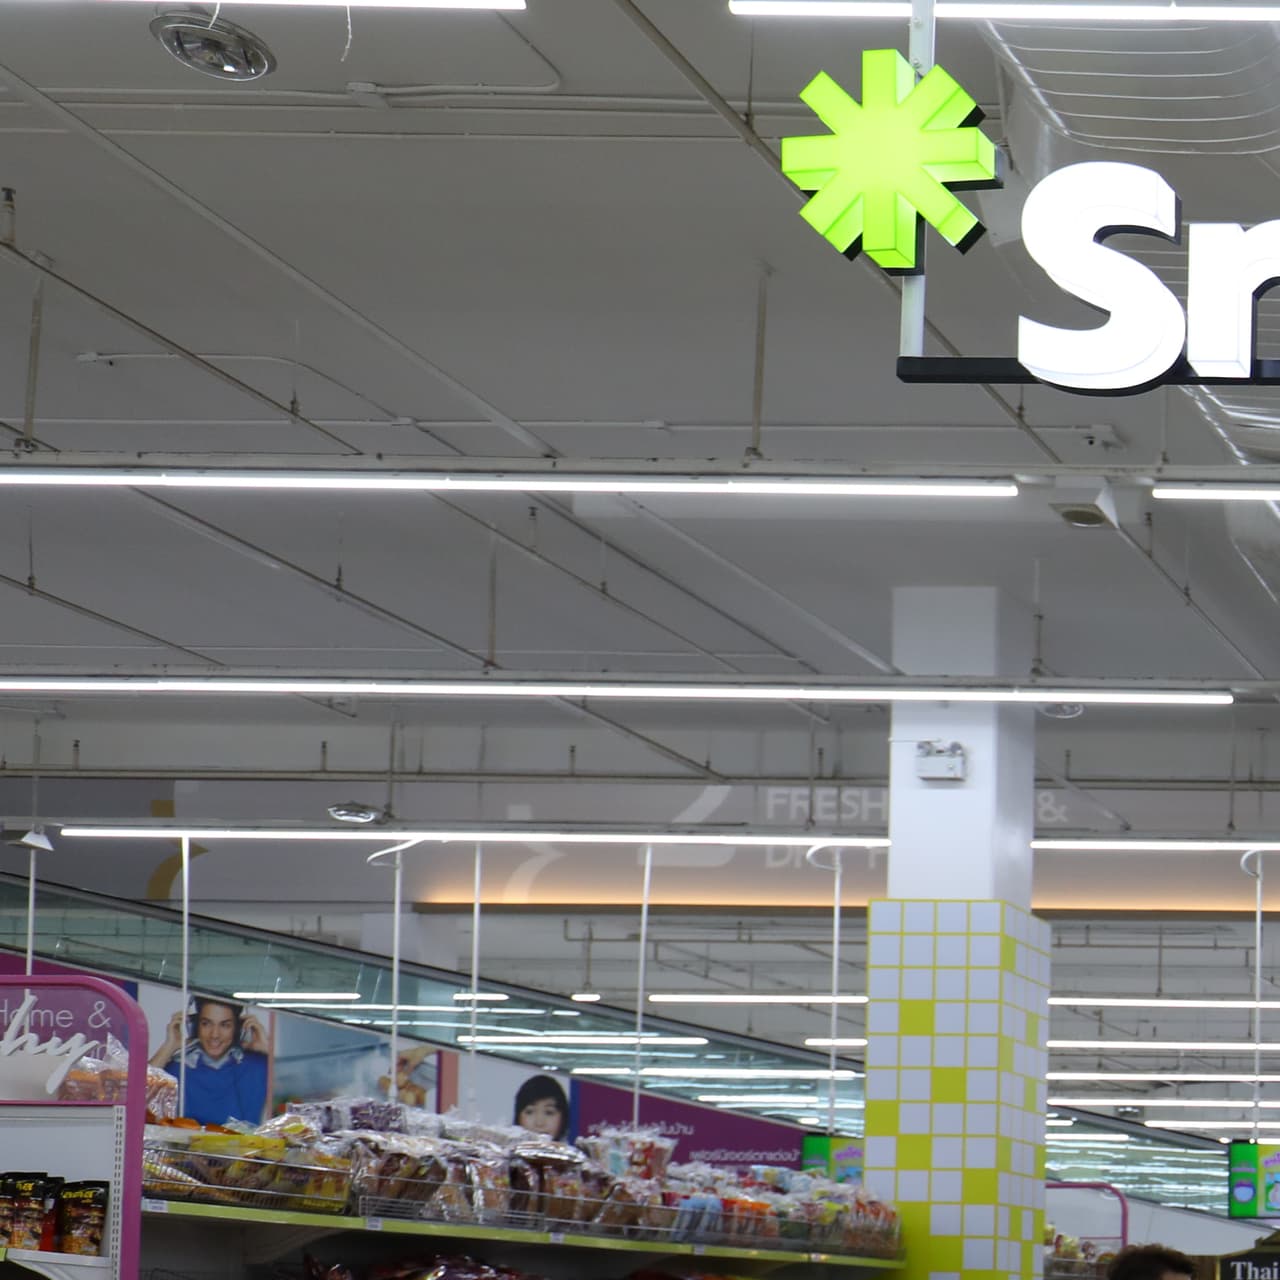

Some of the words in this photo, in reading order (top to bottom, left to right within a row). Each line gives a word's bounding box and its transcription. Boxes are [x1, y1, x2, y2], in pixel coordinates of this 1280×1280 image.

[765, 788, 888, 822] FRESH
[1037, 792, 1068, 822] &
[88, 1000, 111, 1028] &
[1230, 1261, 1278, 1280] Thai
